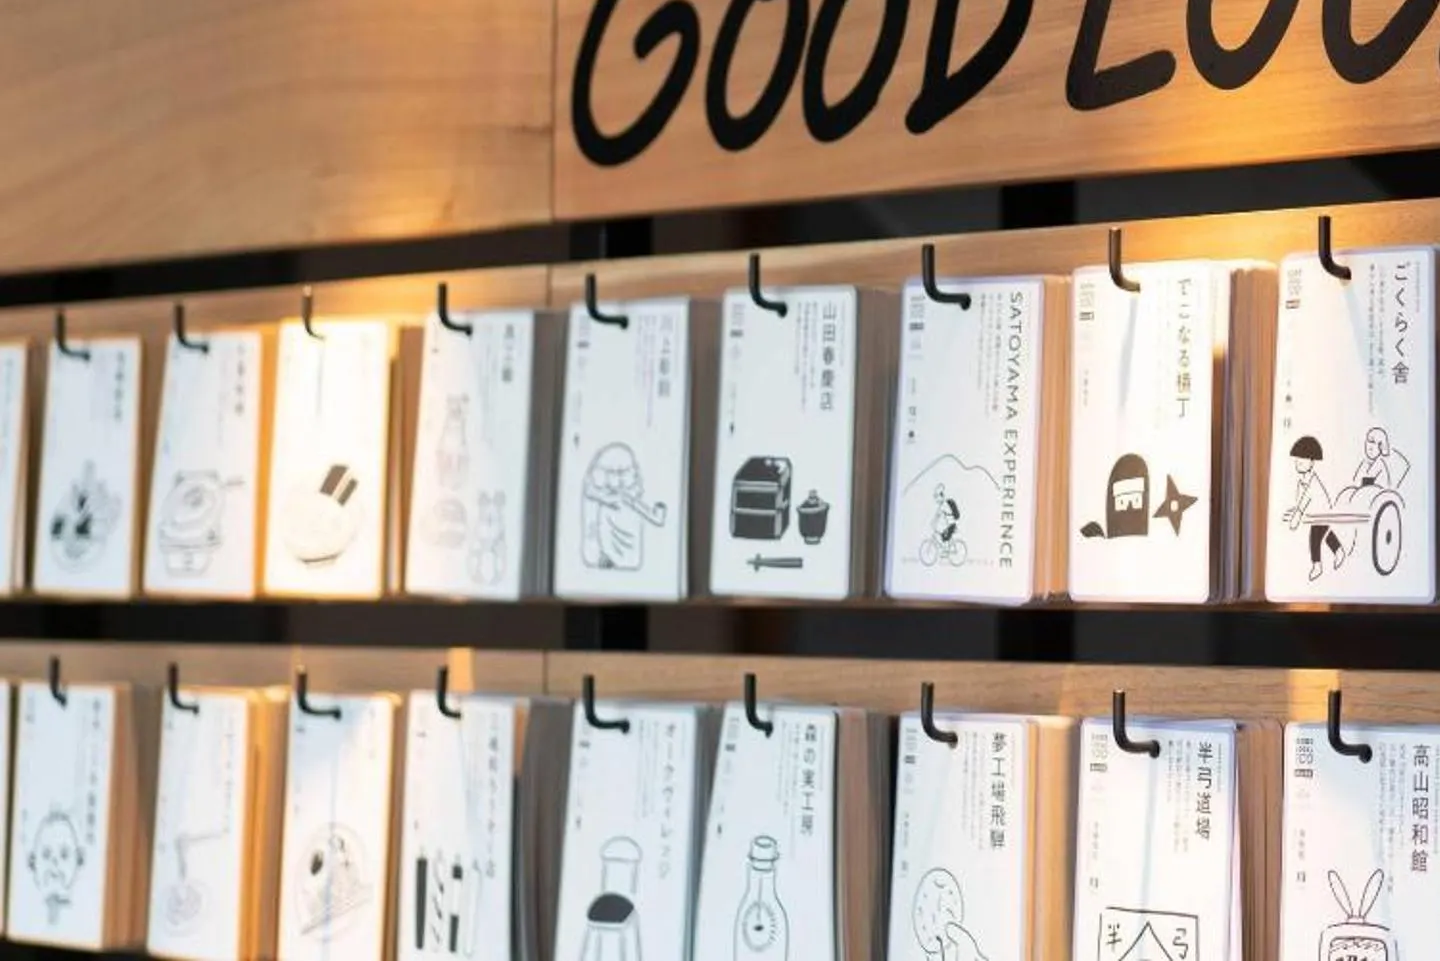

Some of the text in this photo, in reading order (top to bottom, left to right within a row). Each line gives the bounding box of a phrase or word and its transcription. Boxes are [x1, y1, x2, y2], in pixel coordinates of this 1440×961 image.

[1392, 260, 1411, 384] ごくらく舎
[999, 291, 1024, 569] SATOYAMA EXPERIENCE
[1411, 743, 1431, 873] 高山昭和館
